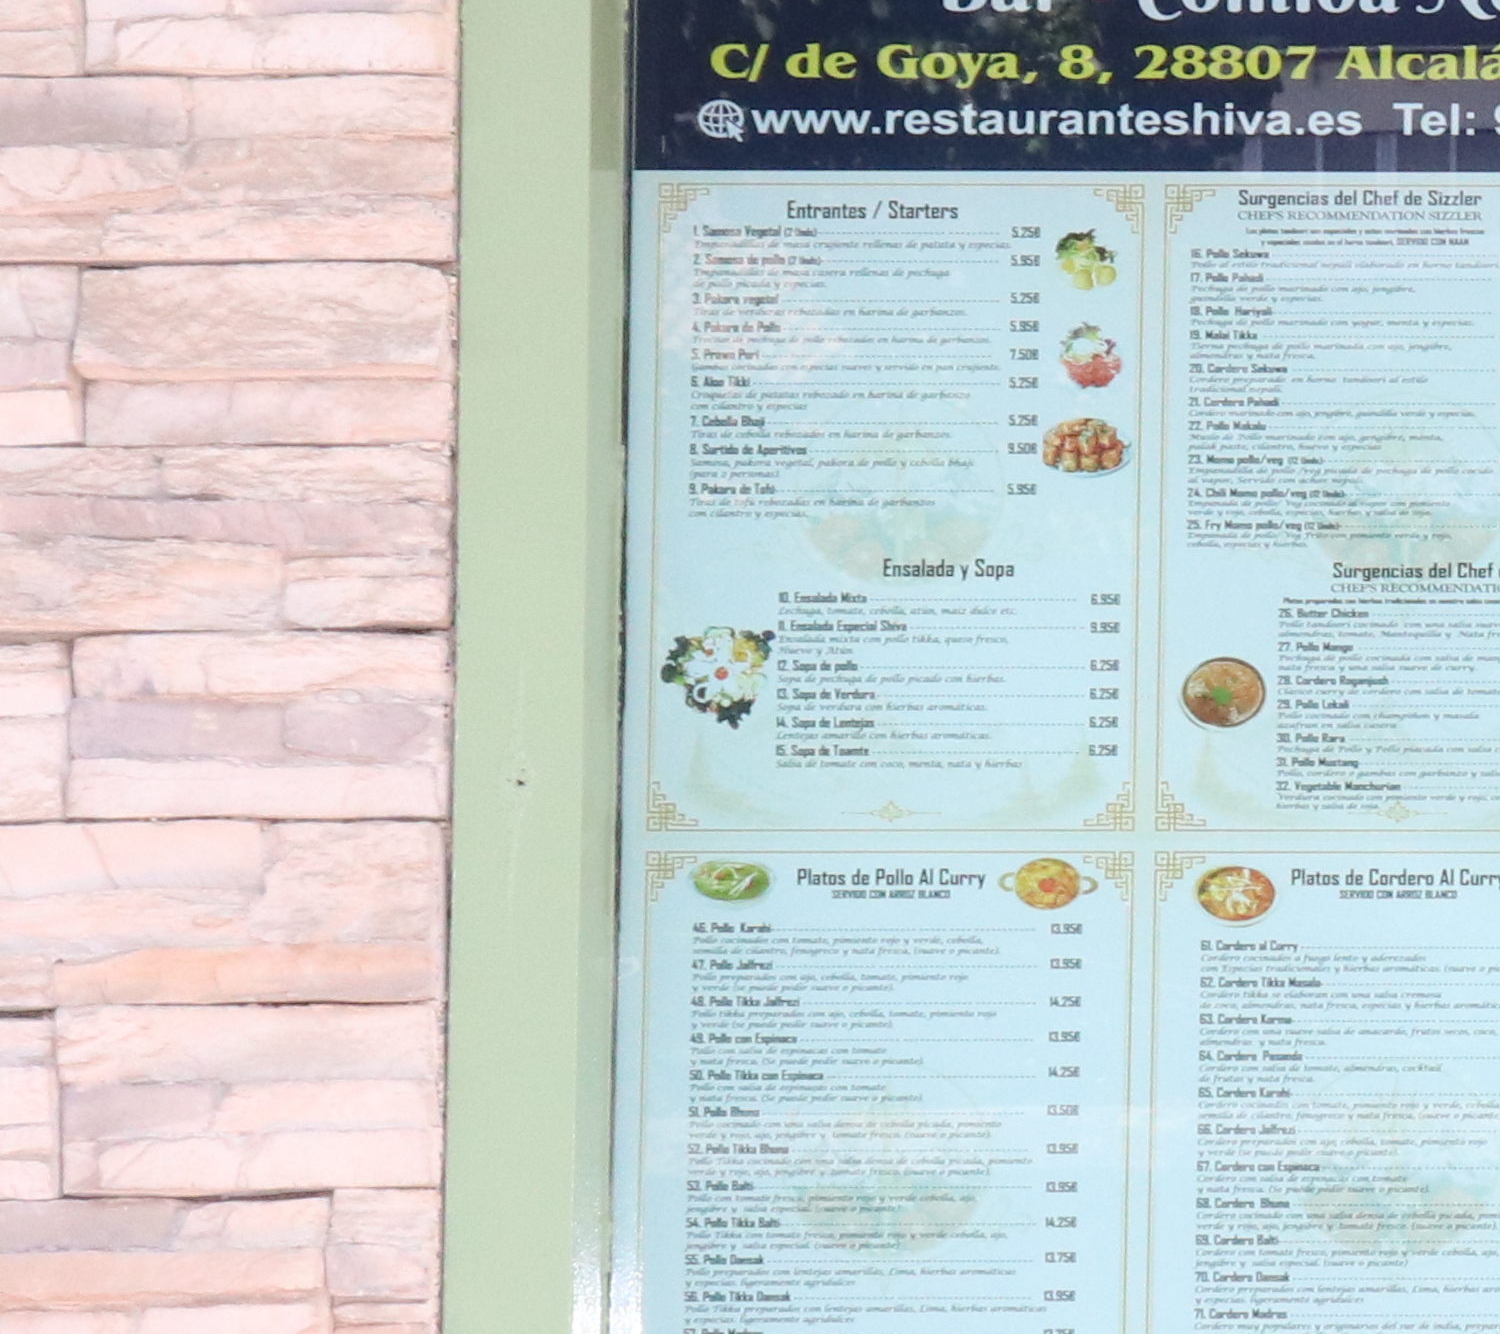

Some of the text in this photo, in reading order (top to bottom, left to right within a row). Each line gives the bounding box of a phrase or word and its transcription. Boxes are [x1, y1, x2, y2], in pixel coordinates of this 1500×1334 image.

[711, 44, 767, 82] C/
[786, 43, 857, 79] de
[877, 44, 1037, 89] Goya,
[1058, 44, 1112, 85] 8,
[1135, 45, 1317, 80] 28807
[751, 102, 1363, 136] www.restauranteshiva.es
[1392, 102, 1475, 136] Tel:
[1239, 190, 1482, 209] Surgencias del Chef de Sizzler
[787, 200, 958, 219] Entrantes / Starters
[1287, 210, 1425, 221] RECOMMENDATION
[1428, 211, 1482, 221] SIZZLER
[883, 558, 1014, 580] Ensalada y Sopa
[1333, 562, 1423, 581] Surgencias
[1428, 562, 1452, 578] del
[1457, 562, 1493, 578] Chef
[820, 688, 831, 700] de
[797, 868, 985, 889] Platos de Pollo Al Curry
[1291, 869, 1339, 885] Platos
[1345, 869, 1363, 886] de
[1369, 869, 1434, 886] Cordero
[1440, 869, 1454, 885] Al
